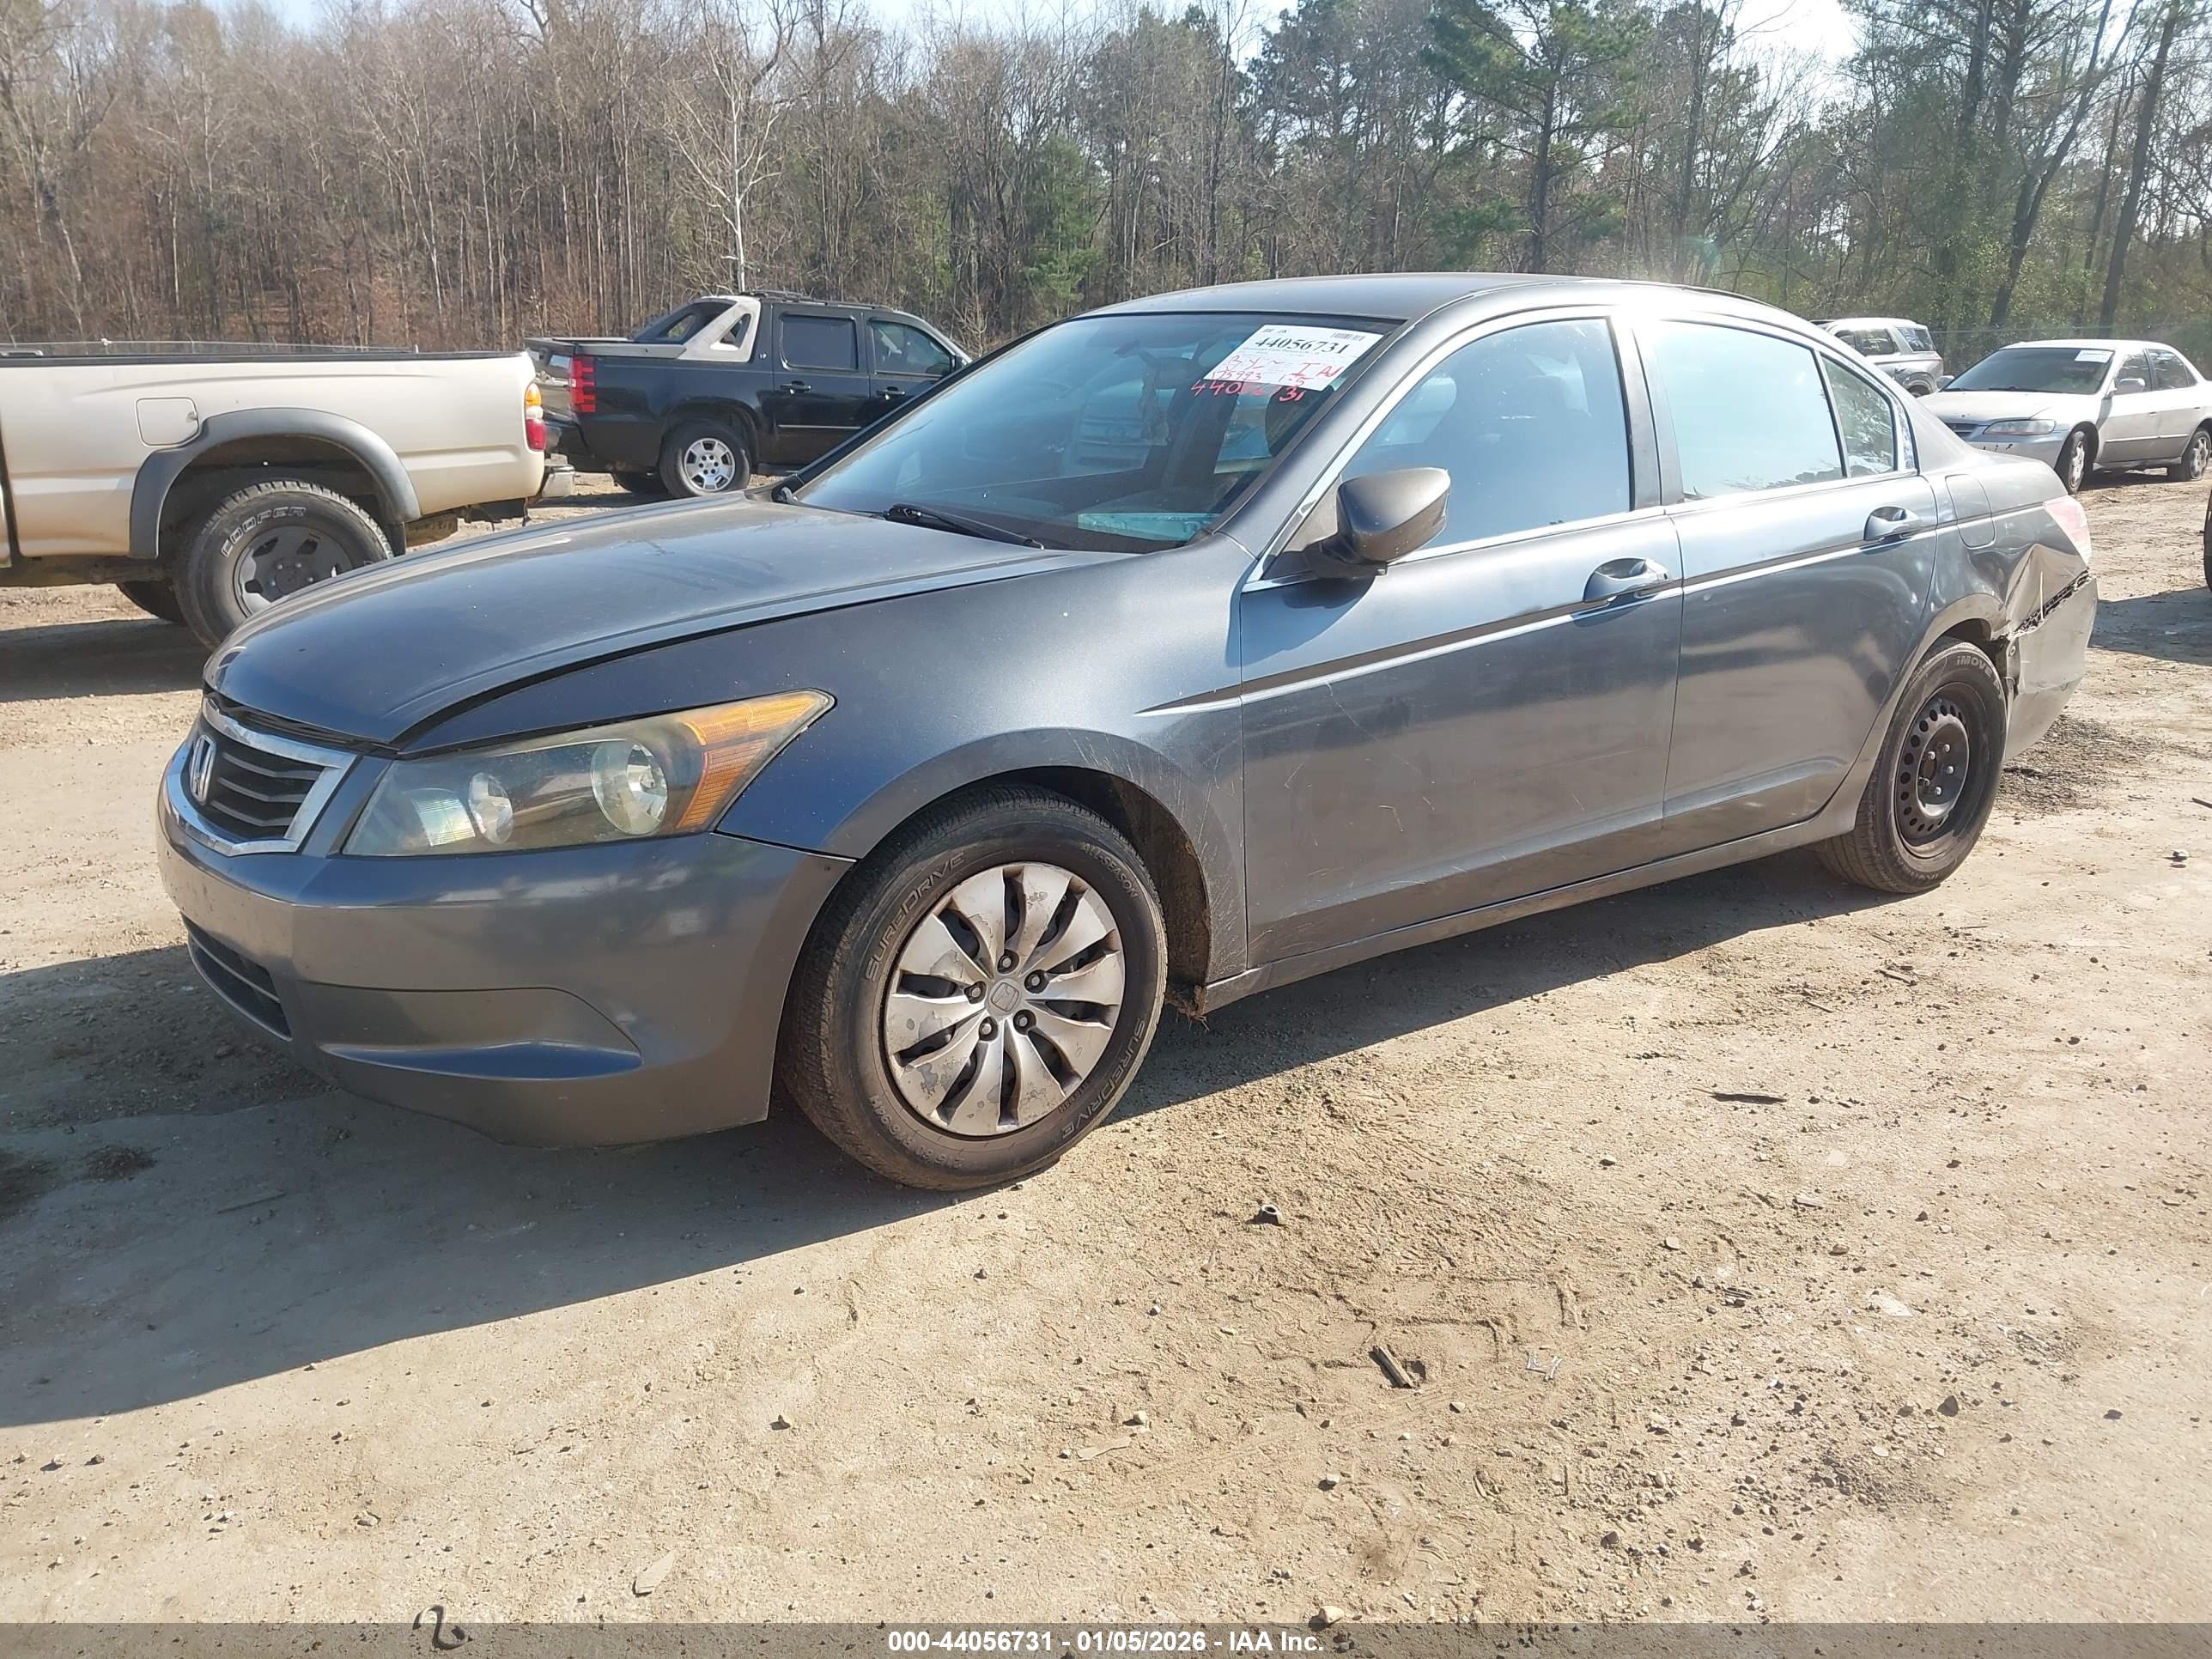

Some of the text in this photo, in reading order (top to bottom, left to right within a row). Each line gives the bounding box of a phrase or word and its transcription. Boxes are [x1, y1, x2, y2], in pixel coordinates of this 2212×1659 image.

[1255, 336, 1351, 355] 44056731
[220, 505, 307, 557] COOPER
[1956, 654, 1993, 681] iMOVE
